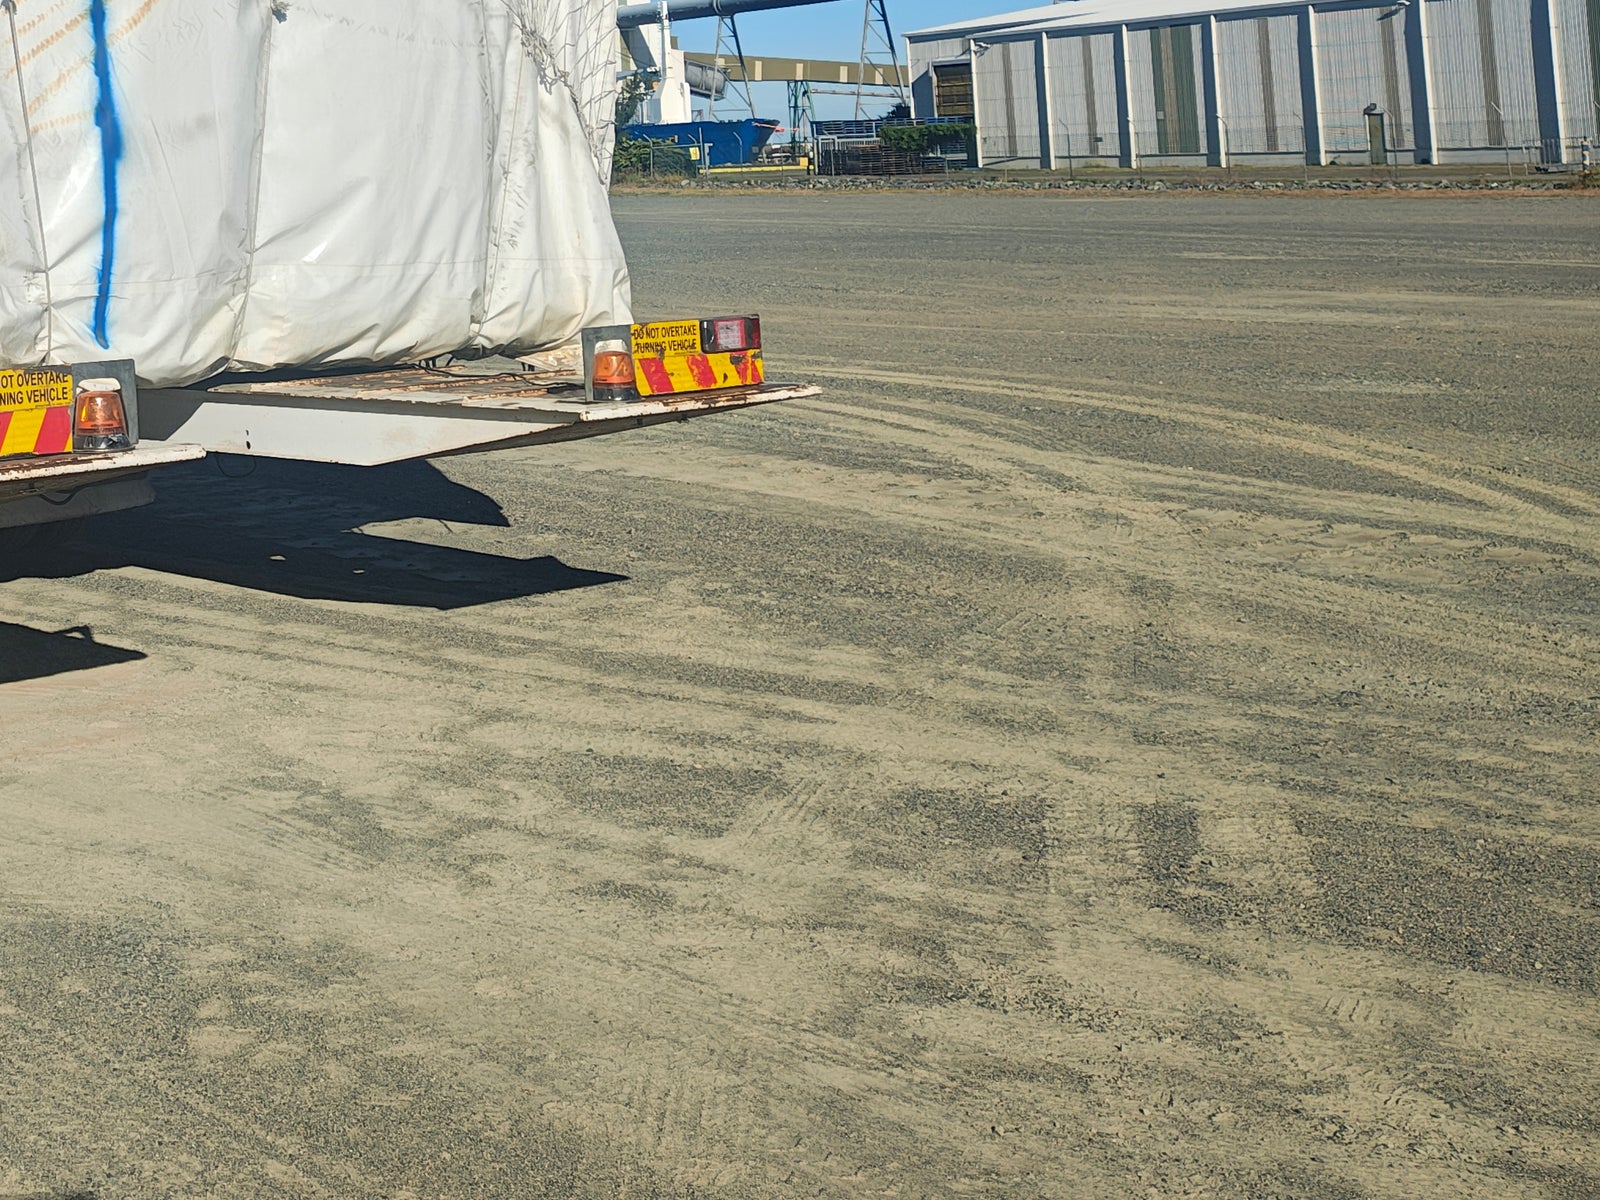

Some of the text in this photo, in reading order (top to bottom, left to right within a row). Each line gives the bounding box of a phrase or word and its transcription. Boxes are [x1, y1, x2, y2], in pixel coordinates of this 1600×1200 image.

[645, 327, 659, 339] NOT
[661, 324, 697, 337] OVERTAKE
[668, 338, 697, 351] VEHICLE
[16, 372, 68, 387] OVERTAKE
[26, 387, 68, 403] VEHICLE
